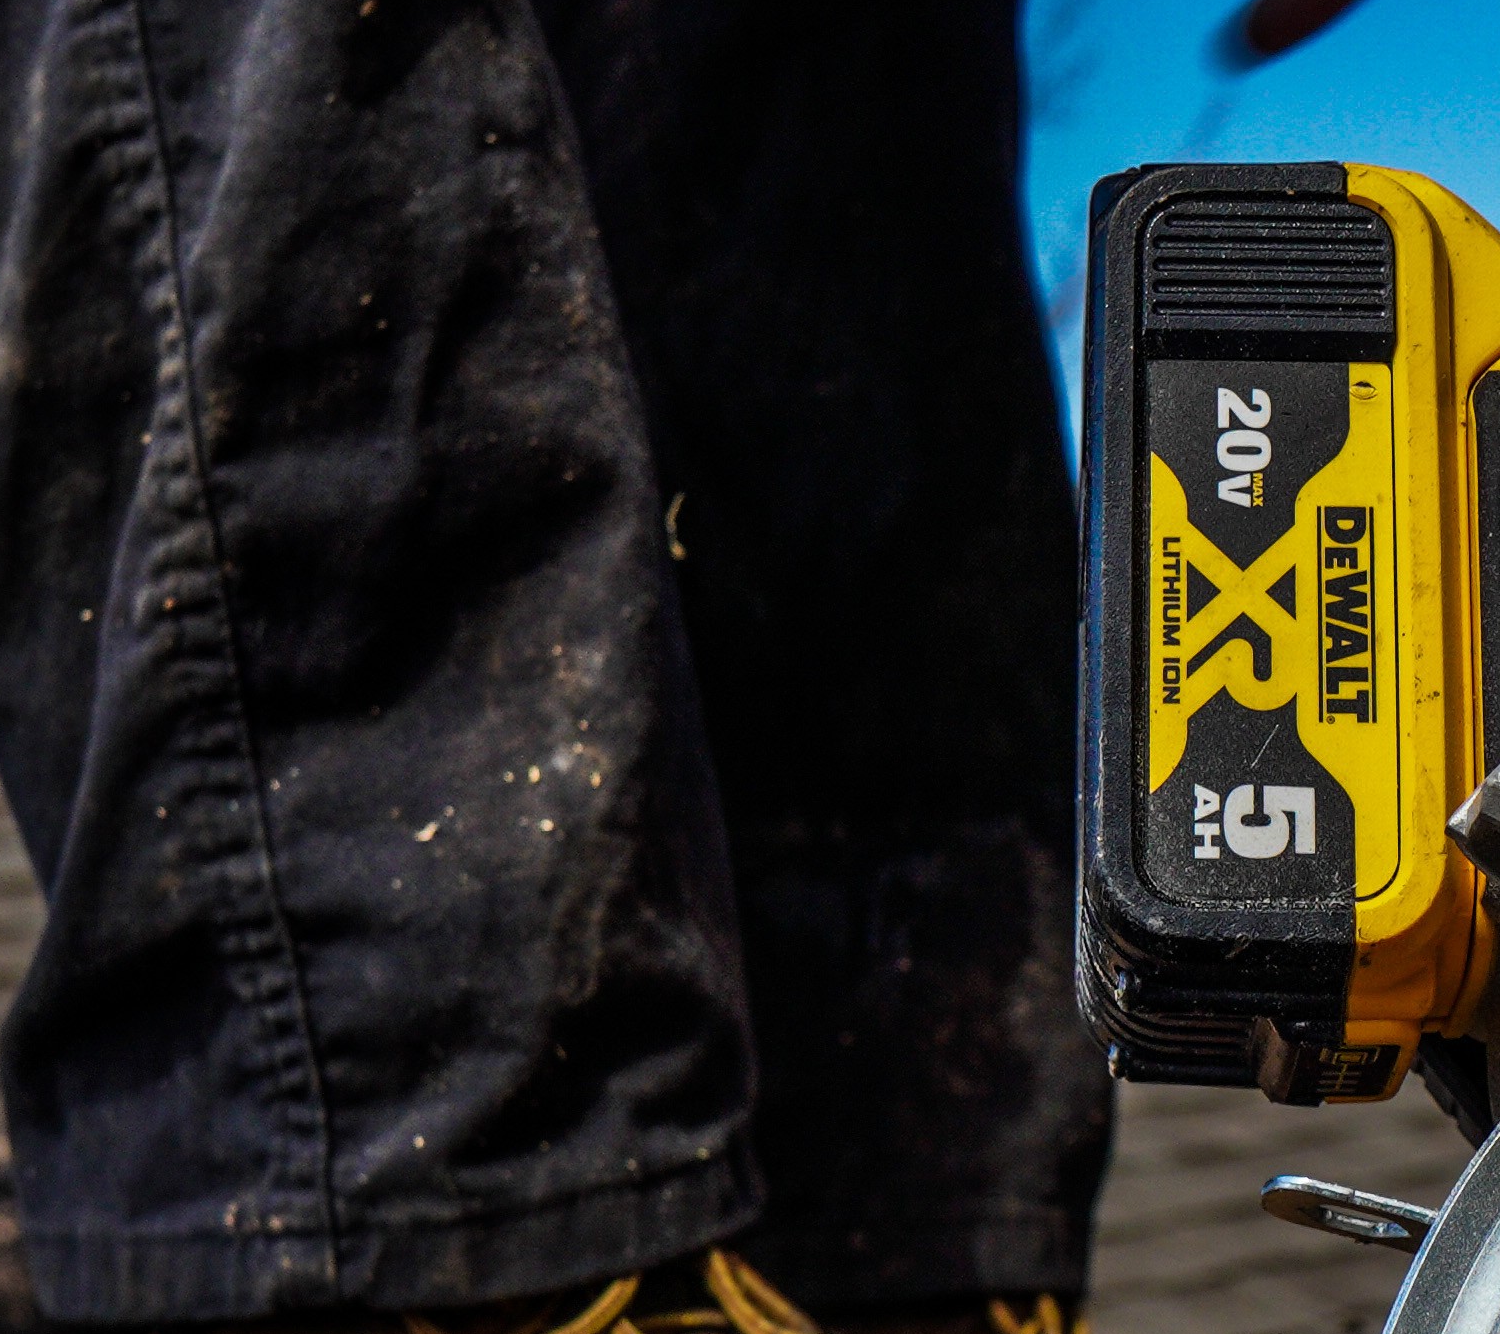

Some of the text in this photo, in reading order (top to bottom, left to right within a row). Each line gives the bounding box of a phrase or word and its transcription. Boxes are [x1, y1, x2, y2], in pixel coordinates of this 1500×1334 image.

[1216, 387, 1272, 508] 20V
[1252, 472, 1265, 508] MAX
[1161, 536, 1181, 705] LITHIUM ION
[1172, 517, 1299, 713] XR
[1321, 505, 1373, 724] DEWALT
[1193, 782, 1221, 860] AH
[1223, 783, 1316, 860] 5
